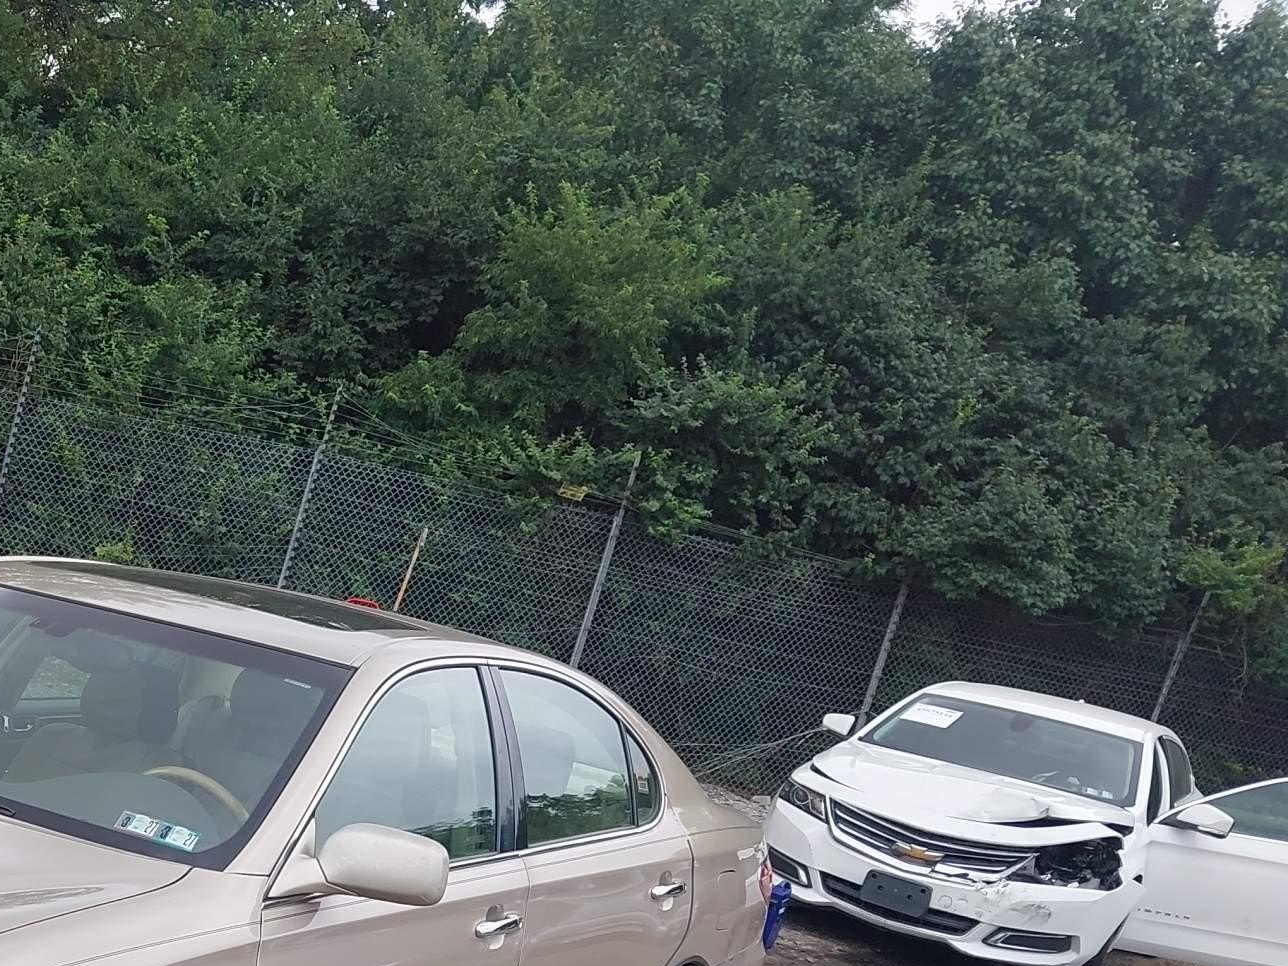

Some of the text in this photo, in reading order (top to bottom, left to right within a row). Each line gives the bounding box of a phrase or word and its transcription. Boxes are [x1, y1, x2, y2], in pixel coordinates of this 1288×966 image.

[121, 816, 158, 834] 3 27
[160, 826, 198, 847] 3 27
